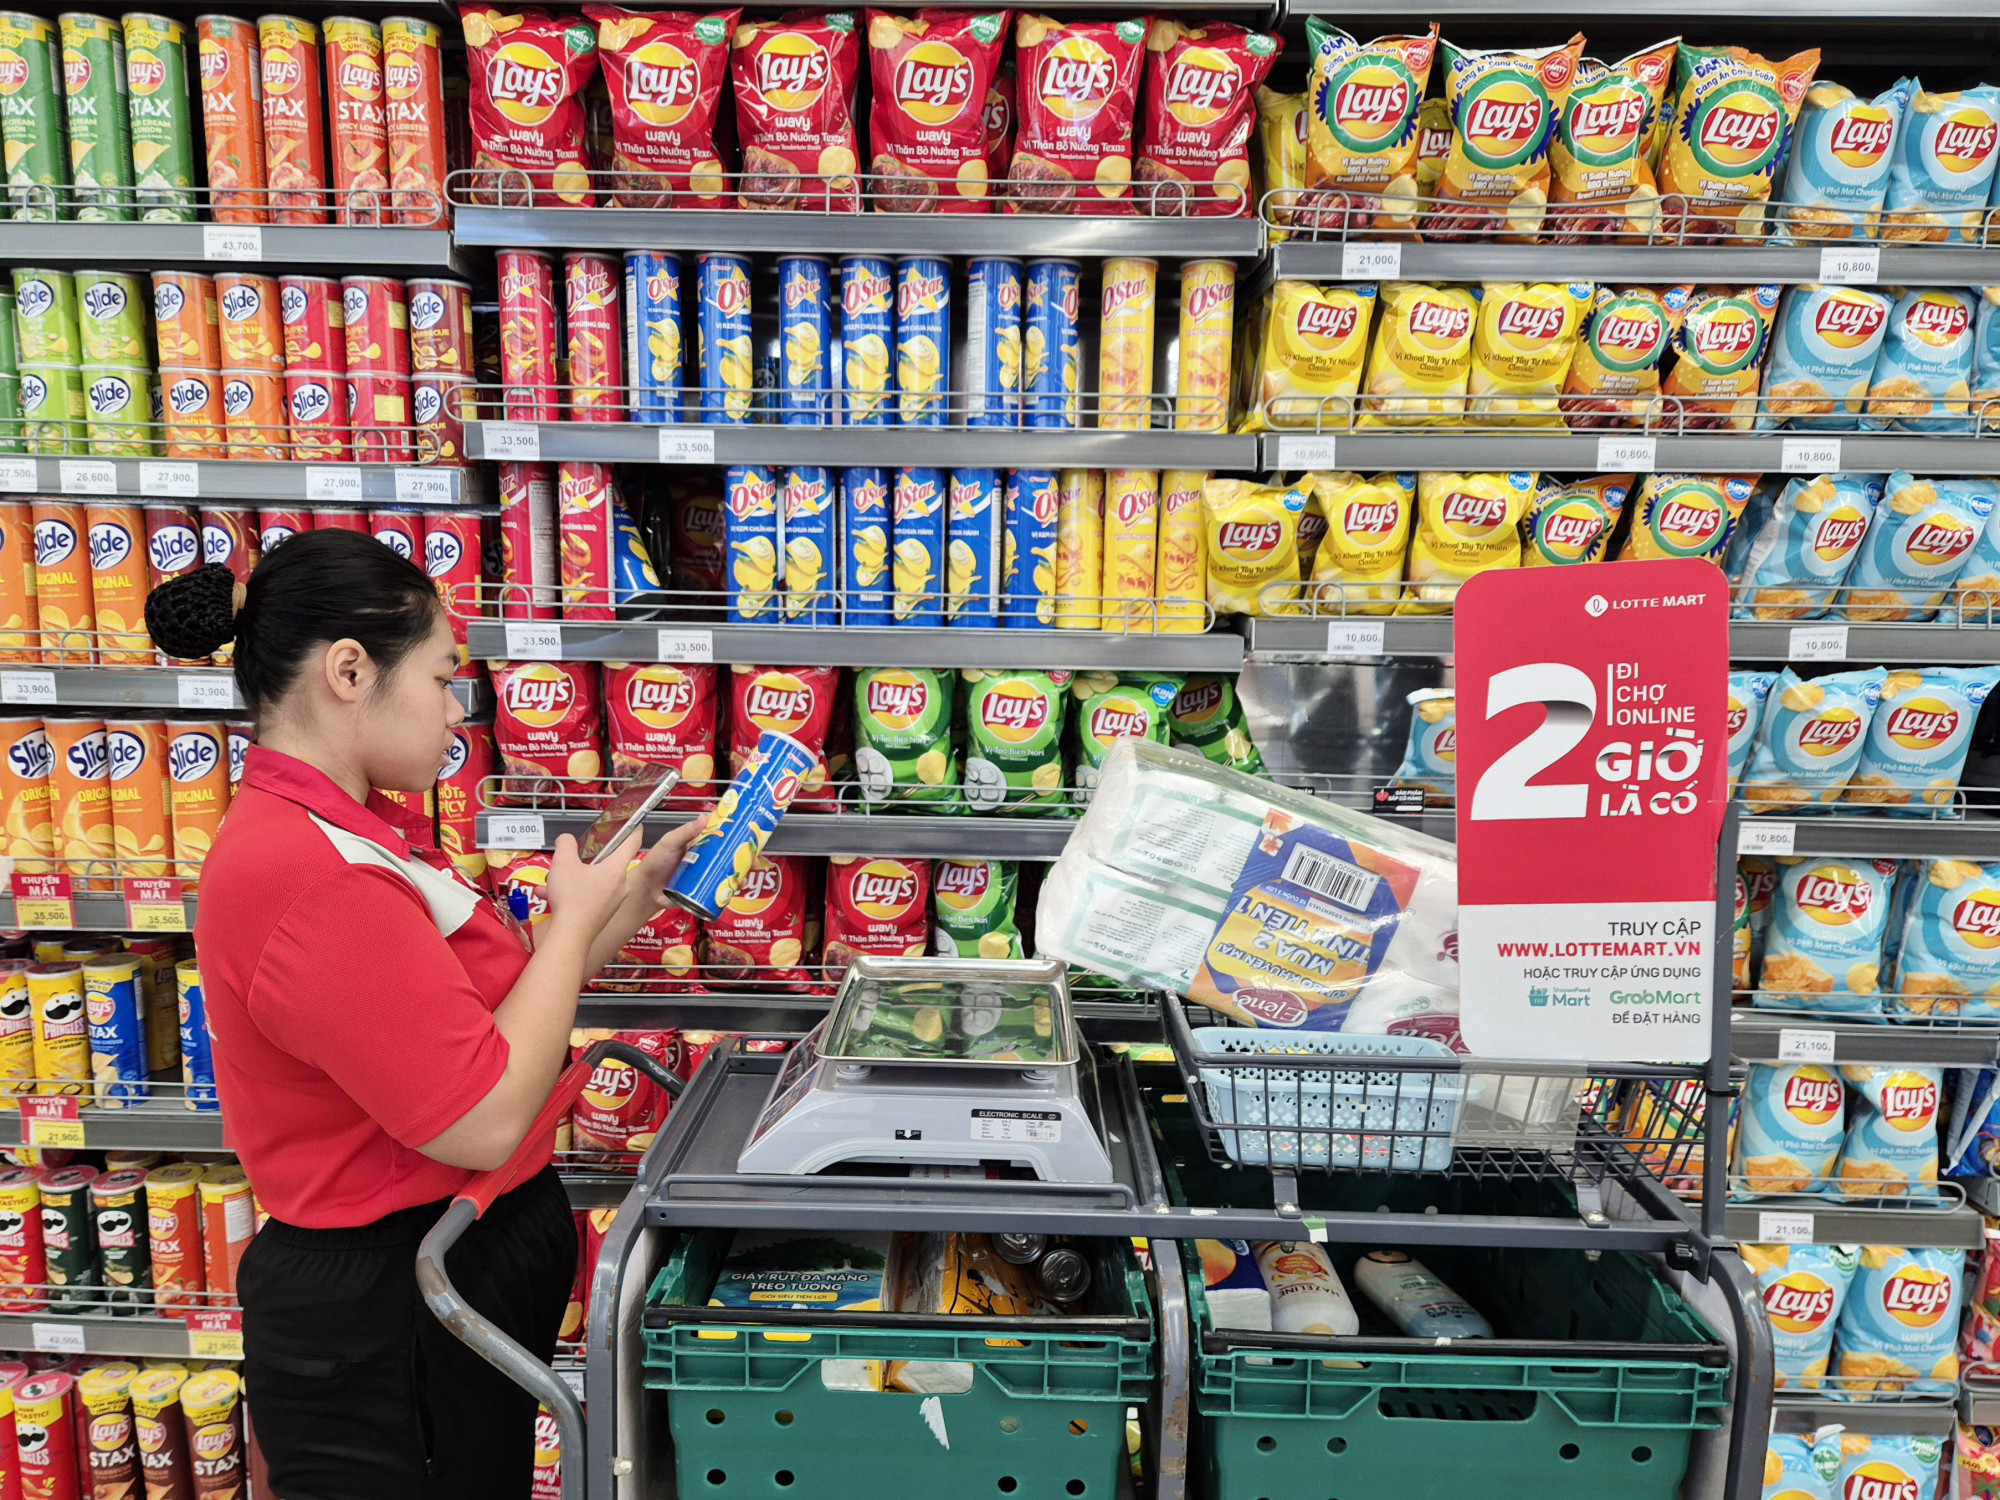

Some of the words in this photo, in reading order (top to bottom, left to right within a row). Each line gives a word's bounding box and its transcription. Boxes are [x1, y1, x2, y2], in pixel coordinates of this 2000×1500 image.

[492, 59, 560, 107] Lay's
[631, 58, 695, 107] Lay's
[900, 59, 968, 107] Lay's
[1043, 57, 1111, 103] Lay's
[1339, 84, 1405, 124] Lay's
[1056, 126, 1092, 142] wavy
[1470, 100, 1534, 142] Lay's
[1704, 108, 1776, 150] Lay's
[1833, 117, 1891, 155] Lay's
[645, 130, 681, 146] wavy
[1101, 142, 1126, 153] Texas
[85, 285, 122, 317] Slide
[846, 277, 890, 317] O'Star
[898, 276, 943, 318] O'Star
[1103, 278, 1147, 319] O'Star
[1300, 301, 1356, 339] Lay's
[1500, 301, 1563, 339] Lay's
[1818, 298, 1884, 335] Lay's
[89, 380, 126, 411] Slide
[1663, 501, 1720, 538] Lay's
[151, 528, 198, 568] Slide
[1613, 598, 1659, 610] LOTTE
[1662, 594, 1706, 607] MART
[1616, 662, 1639, 680] ĐI
[510, 678, 570, 719] Lay's
[1153, 687, 1175, 699] KING
[1616, 683, 1667, 705] CHỢ
[984, 693, 1046, 730] Lay's
[1616, 706, 1696, 726] ONLINE
[1890, 707, 1958, 741] Lay's
[1470, 662, 1597, 821] 2
[1600, 783, 1643, 817] LÀ
[855, 874, 914, 906] Lay's
[733, 918, 764, 930] wavy
[1250, 902, 1309, 939] TIỀN
[1608, 920, 1658, 937] TRUY
[1662, 918, 1701, 938] CẬP
[1252, 931, 1276, 951] 2
[1498, 941, 1701, 957] WWW.LOTTEMART.VN
[1276, 940, 1336, 977] MUA
[1523, 966, 1560, 980] HOẶC
[1563, 967, 1598, 979] TRUY
[1600, 965, 1628, 981] CẬP
[1631, 965, 1660, 978] ỨNG
[1663, 967, 1701, 980] DỤNG
[1552, 986, 1591, 994] ShopeeFood
[1552, 993, 1591, 1007] Mart
[1610, 990, 1701, 1005] GrabMart
[1612, 1010, 1630, 1024] ĐỂ
[1633, 1012, 1660, 1026] ĐẶT
[1663, 1010, 1701, 1024] HÀNG
[979, 1110, 1020, 1119] ELECTRONIC
[750, 1282, 787, 1291] TREO
[1277, 1284, 1340, 1300] HAZELINE
[1888, 1278, 1950, 1315] Lay's
[92, 1416, 129, 1442] Lay's
[89, 1444, 135, 1467] STAX
[194, 1452, 241, 1475] STAX
